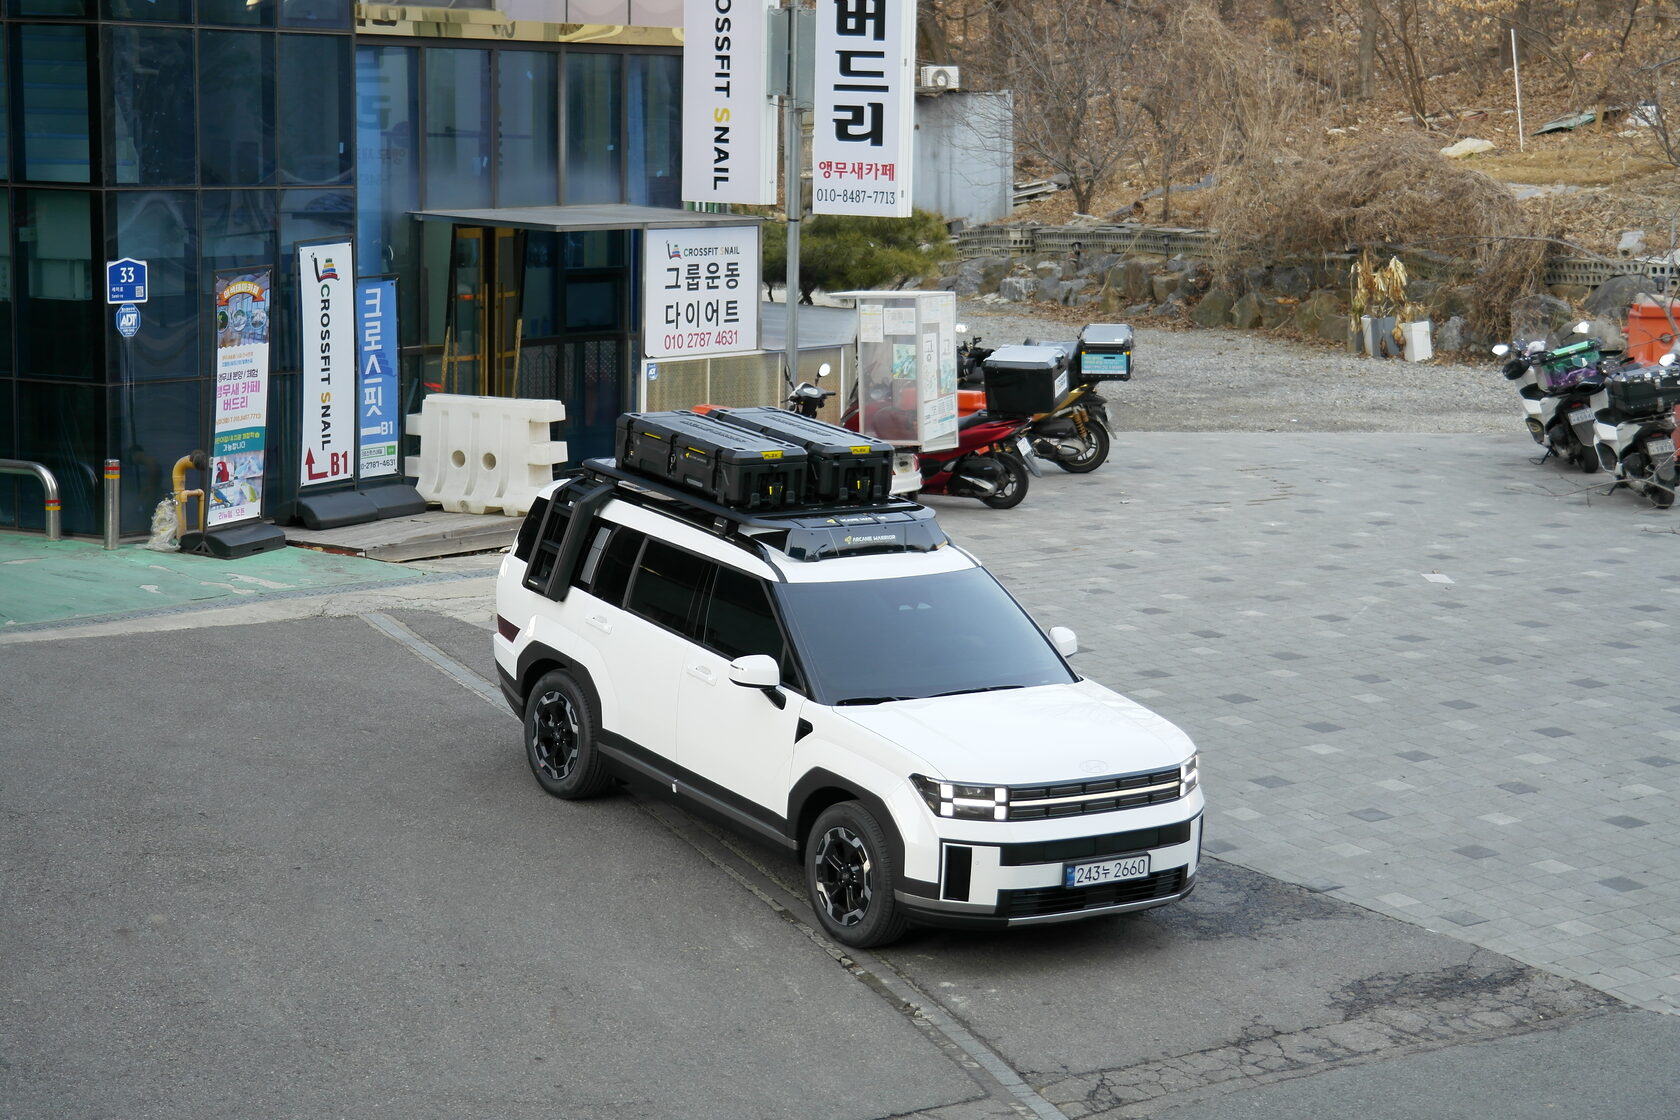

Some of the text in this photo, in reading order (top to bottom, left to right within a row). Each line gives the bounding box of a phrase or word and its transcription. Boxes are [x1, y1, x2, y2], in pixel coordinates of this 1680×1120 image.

[832, 0, 889, 146] 버드리
[713, 107, 731, 190] SNAIL
[818, 160, 895, 181] 앵무새카페
[816, 188, 896, 205] 010-8487-7713
[683, 246, 740, 257] CROSSFIT SNAIL
[120, 267, 135, 283] 33
[665, 262, 740, 291] 그룹운동
[120, 313, 138, 327] ADT
[665, 299, 740, 330] 다이어트
[664, 330, 738, 350] 010 2787 4631
[363, 287, 383, 417] 크로스핏
[320, 284, 332, 451] CROSSFIT SNAIL
[241, 380, 261, 393] 카페
[223, 395, 249, 411] 버드리
[380, 421, 393, 436] B1
[330, 450, 348, 477] B1
[1076, 859, 1146, 884] 243누 2660
